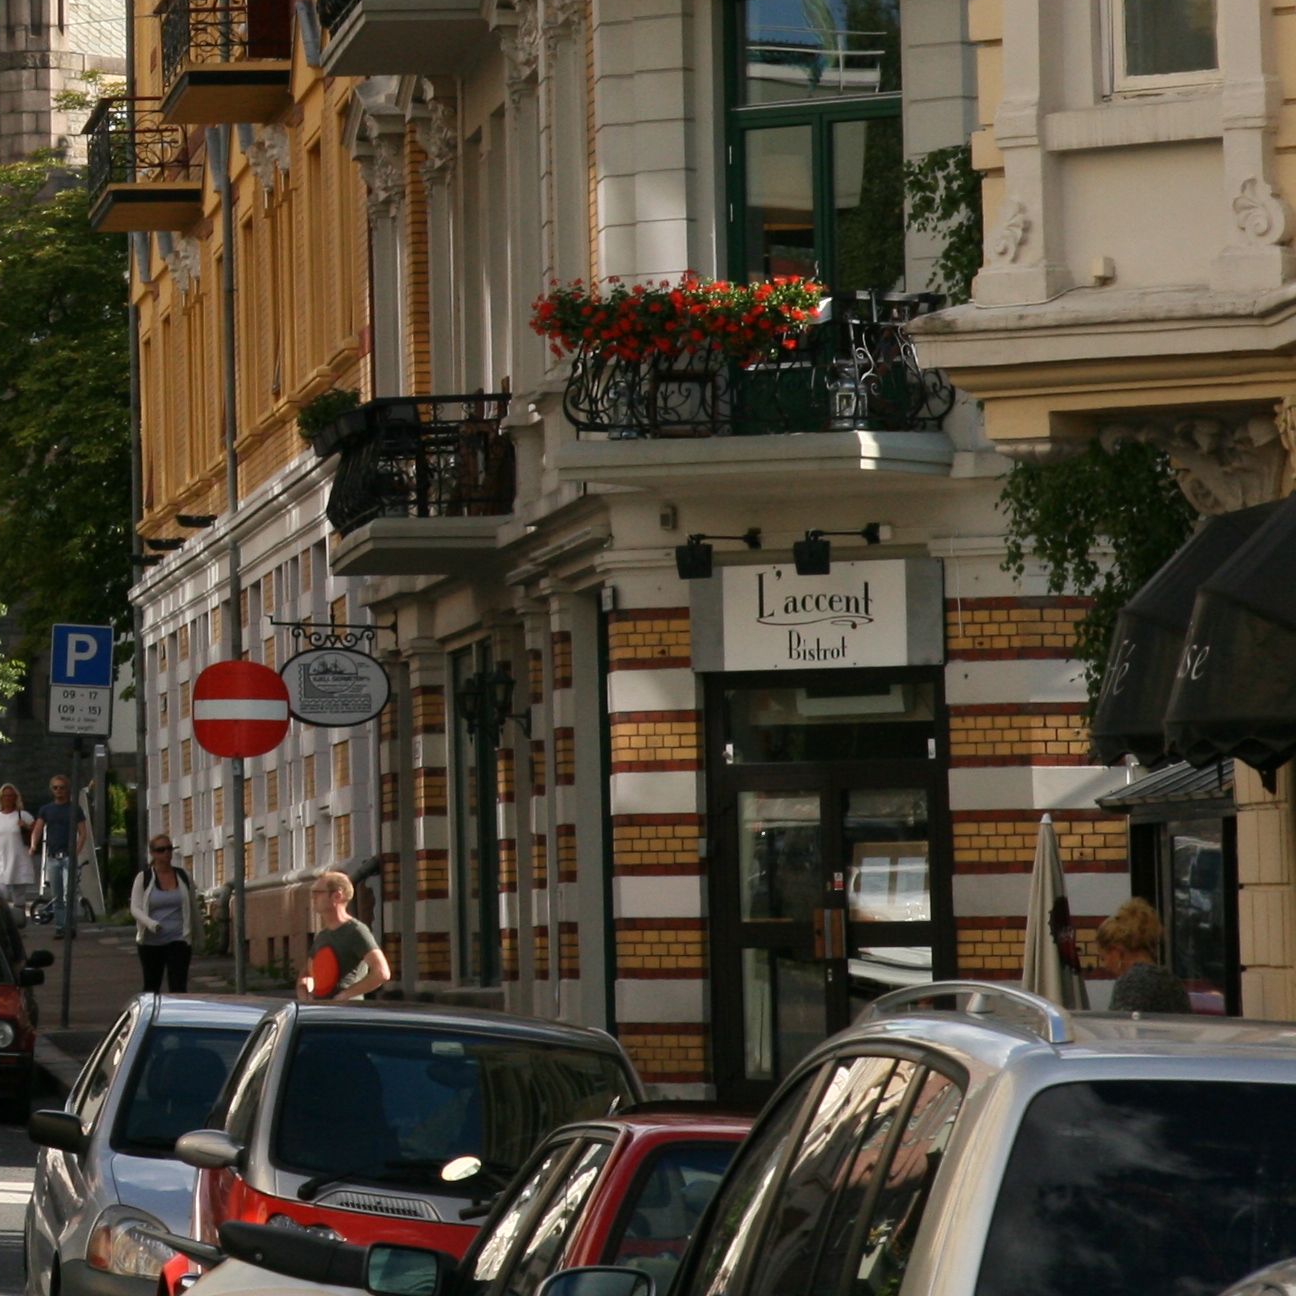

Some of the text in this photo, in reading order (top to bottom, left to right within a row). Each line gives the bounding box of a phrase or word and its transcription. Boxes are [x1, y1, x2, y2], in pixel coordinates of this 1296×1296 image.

[66, 633, 98, 678] P
[788, 629, 848, 661] Bistrot
[1177, 644, 1210, 680] se
[58, 704, 75, 714] (09
[88, 706, 102, 716] 15)
[63, 689, 76, 699] 09
[89, 691, 98, 700] 17
